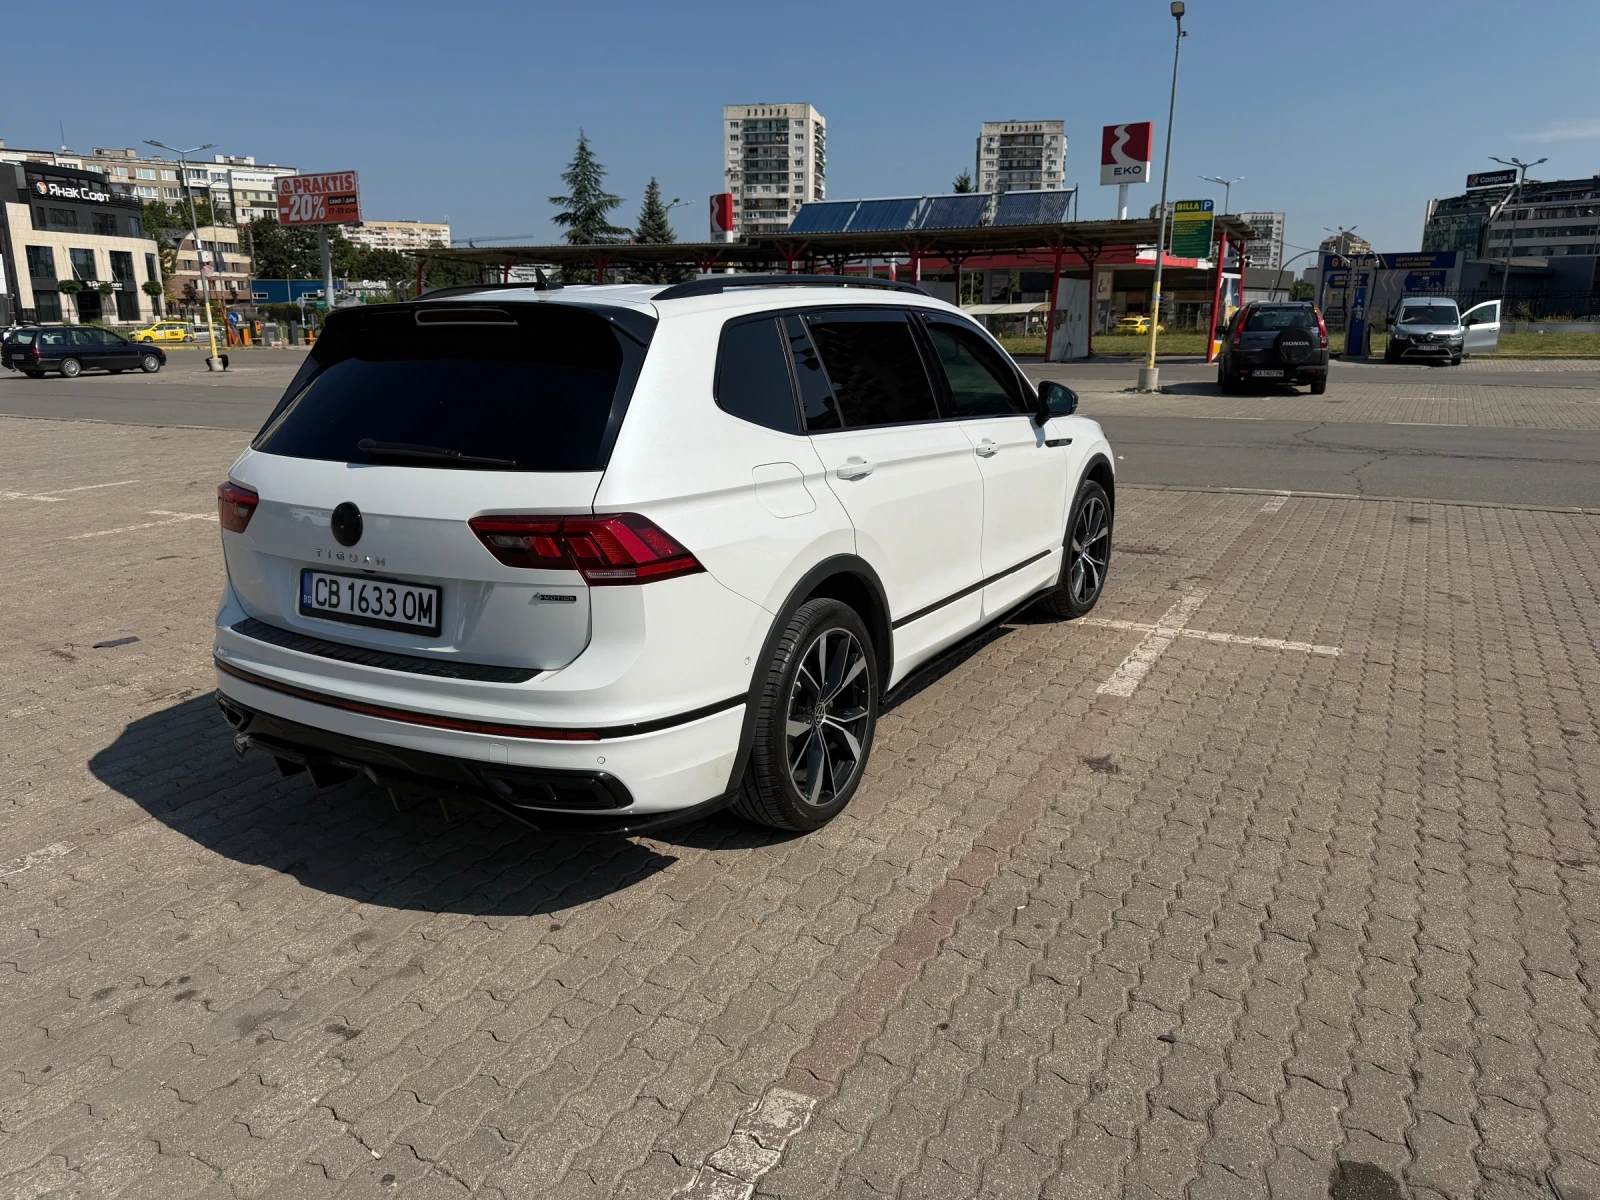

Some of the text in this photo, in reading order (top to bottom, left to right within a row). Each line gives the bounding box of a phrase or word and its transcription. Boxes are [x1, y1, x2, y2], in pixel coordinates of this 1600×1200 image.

[1114, 166, 1142, 176] EKO
[48, 184, 111, 202] Янак Софт
[293, 174, 353, 194] PRAKTIS
[281, 194, 325, 221] -20%
[1177, 201, 1212, 210] BILLA P
[315, 548, 386, 566] TIGUAN
[303, 577, 433, 624] BG CB 1633 OM
